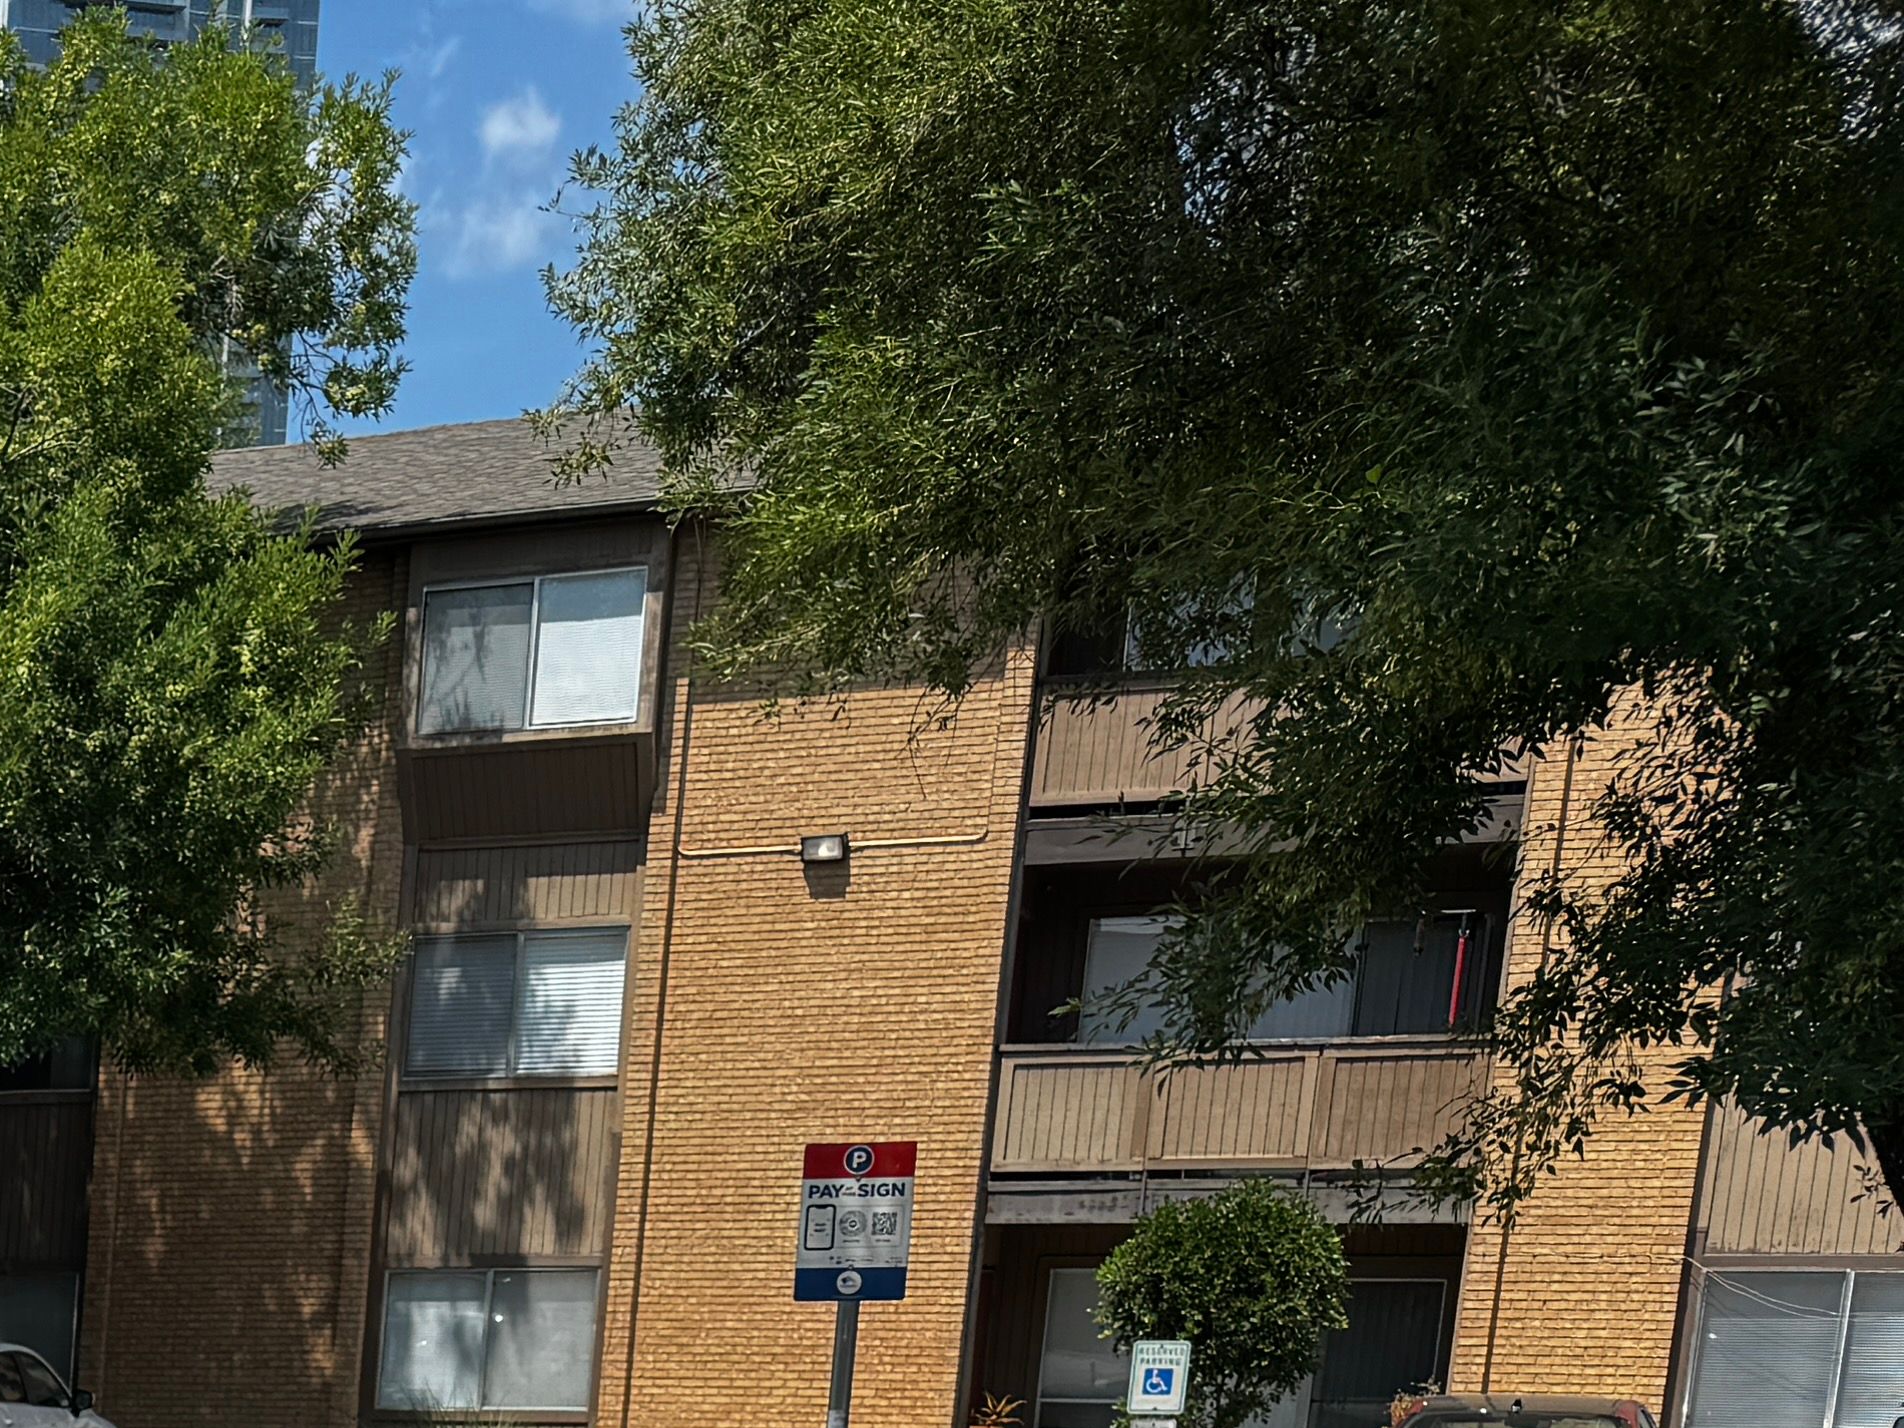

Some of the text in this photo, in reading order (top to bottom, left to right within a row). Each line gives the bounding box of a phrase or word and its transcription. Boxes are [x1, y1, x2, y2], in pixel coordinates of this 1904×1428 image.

[808, 1184, 844, 1199] PAY
[857, 1182, 906, 1198] SIGN
[1139, 1347, 1185, 1356] RESERVED
[1140, 1357, 1182, 1366] PARKING
